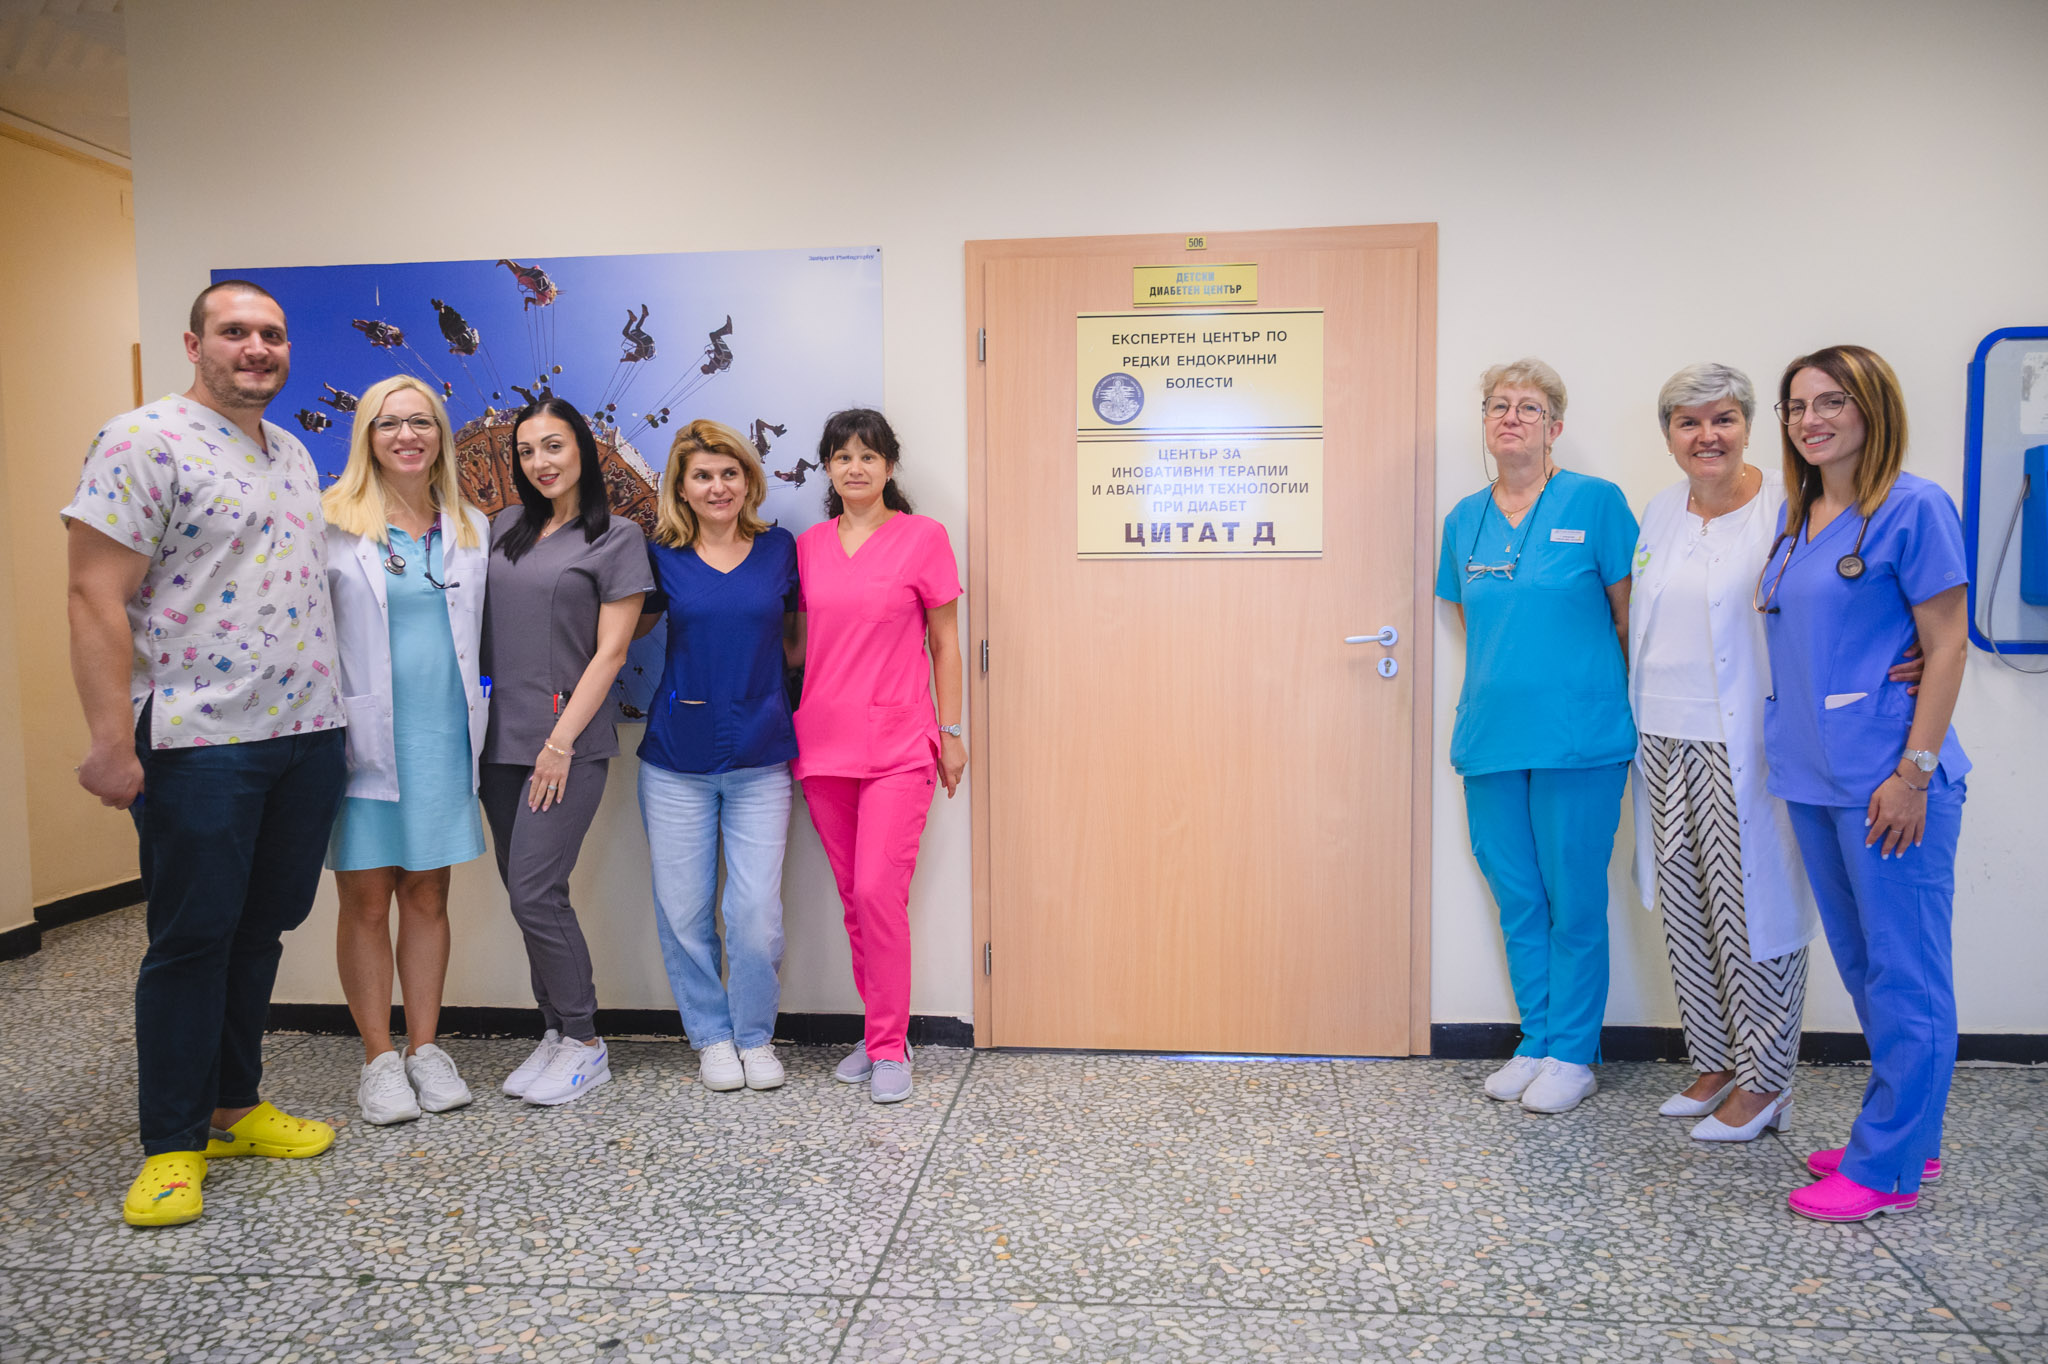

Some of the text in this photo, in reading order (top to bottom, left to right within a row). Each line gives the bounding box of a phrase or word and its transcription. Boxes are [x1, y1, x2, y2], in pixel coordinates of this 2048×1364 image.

[1188, 238, 1203, 247] 506
[1176, 272, 1215, 283] ДЕТСКИ
[1149, 285, 1242, 297] ДИАБЕТЕН ЦЕНТЪР
[1112, 331, 1287, 345] ЕКСПЕРТЕН ЦЕНТЪР ПО
[1123, 354, 1277, 368] РЕДКИ ЕНДОКРИННИ
[1166, 377, 1233, 388] БОЛЕСТИ
[1158, 448, 1241, 461] ЦЕНТЪР ЗА
[1112, 465, 1288, 478] ИНОВАТИВНИ ТЕРАПИИ
[1092, 482, 1309, 496] И АВАНГАРДНИ ТЕХНОЛОГИИ
[1153, 500, 1247, 514] ПРИ ДИАБЕТ
[1125, 522, 1275, 547] ЦИТАТ Д
